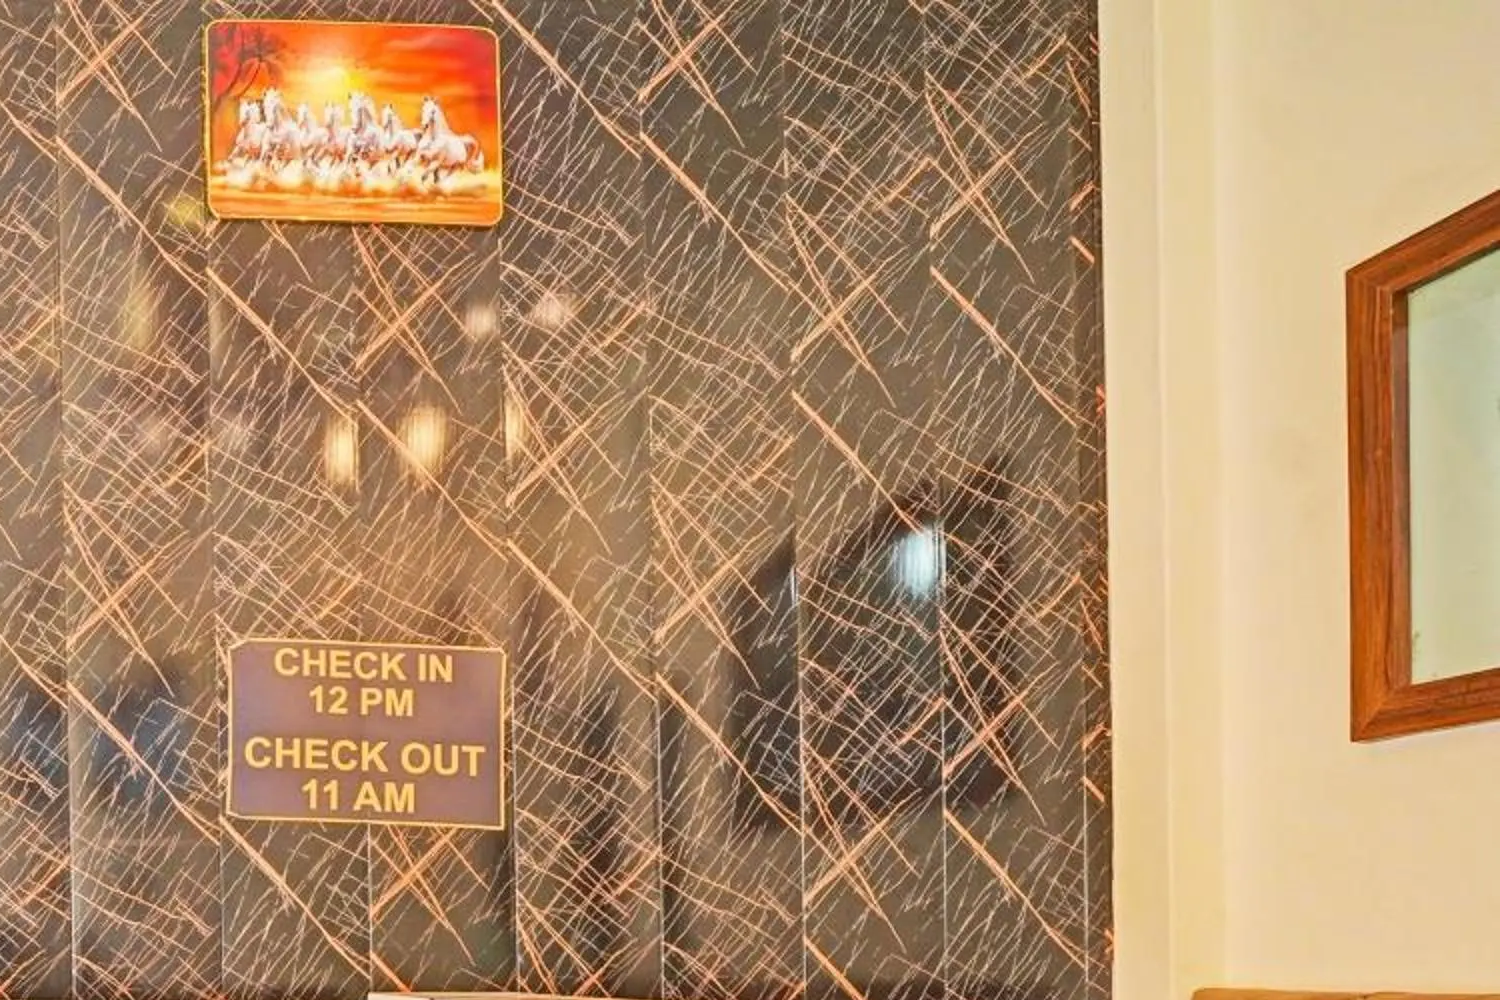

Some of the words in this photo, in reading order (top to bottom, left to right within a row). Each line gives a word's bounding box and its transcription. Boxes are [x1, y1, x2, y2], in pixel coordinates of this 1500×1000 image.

[274, 648, 406, 681] CHECK
[418, 653, 453, 683] IN
[309, 685, 348, 714] 12
[360, 687, 414, 717] PM
[244, 737, 388, 772] CHECK
[401, 742, 486, 777] OUT
[302, 778, 339, 811] 11
[353, 781, 415, 814] AM
